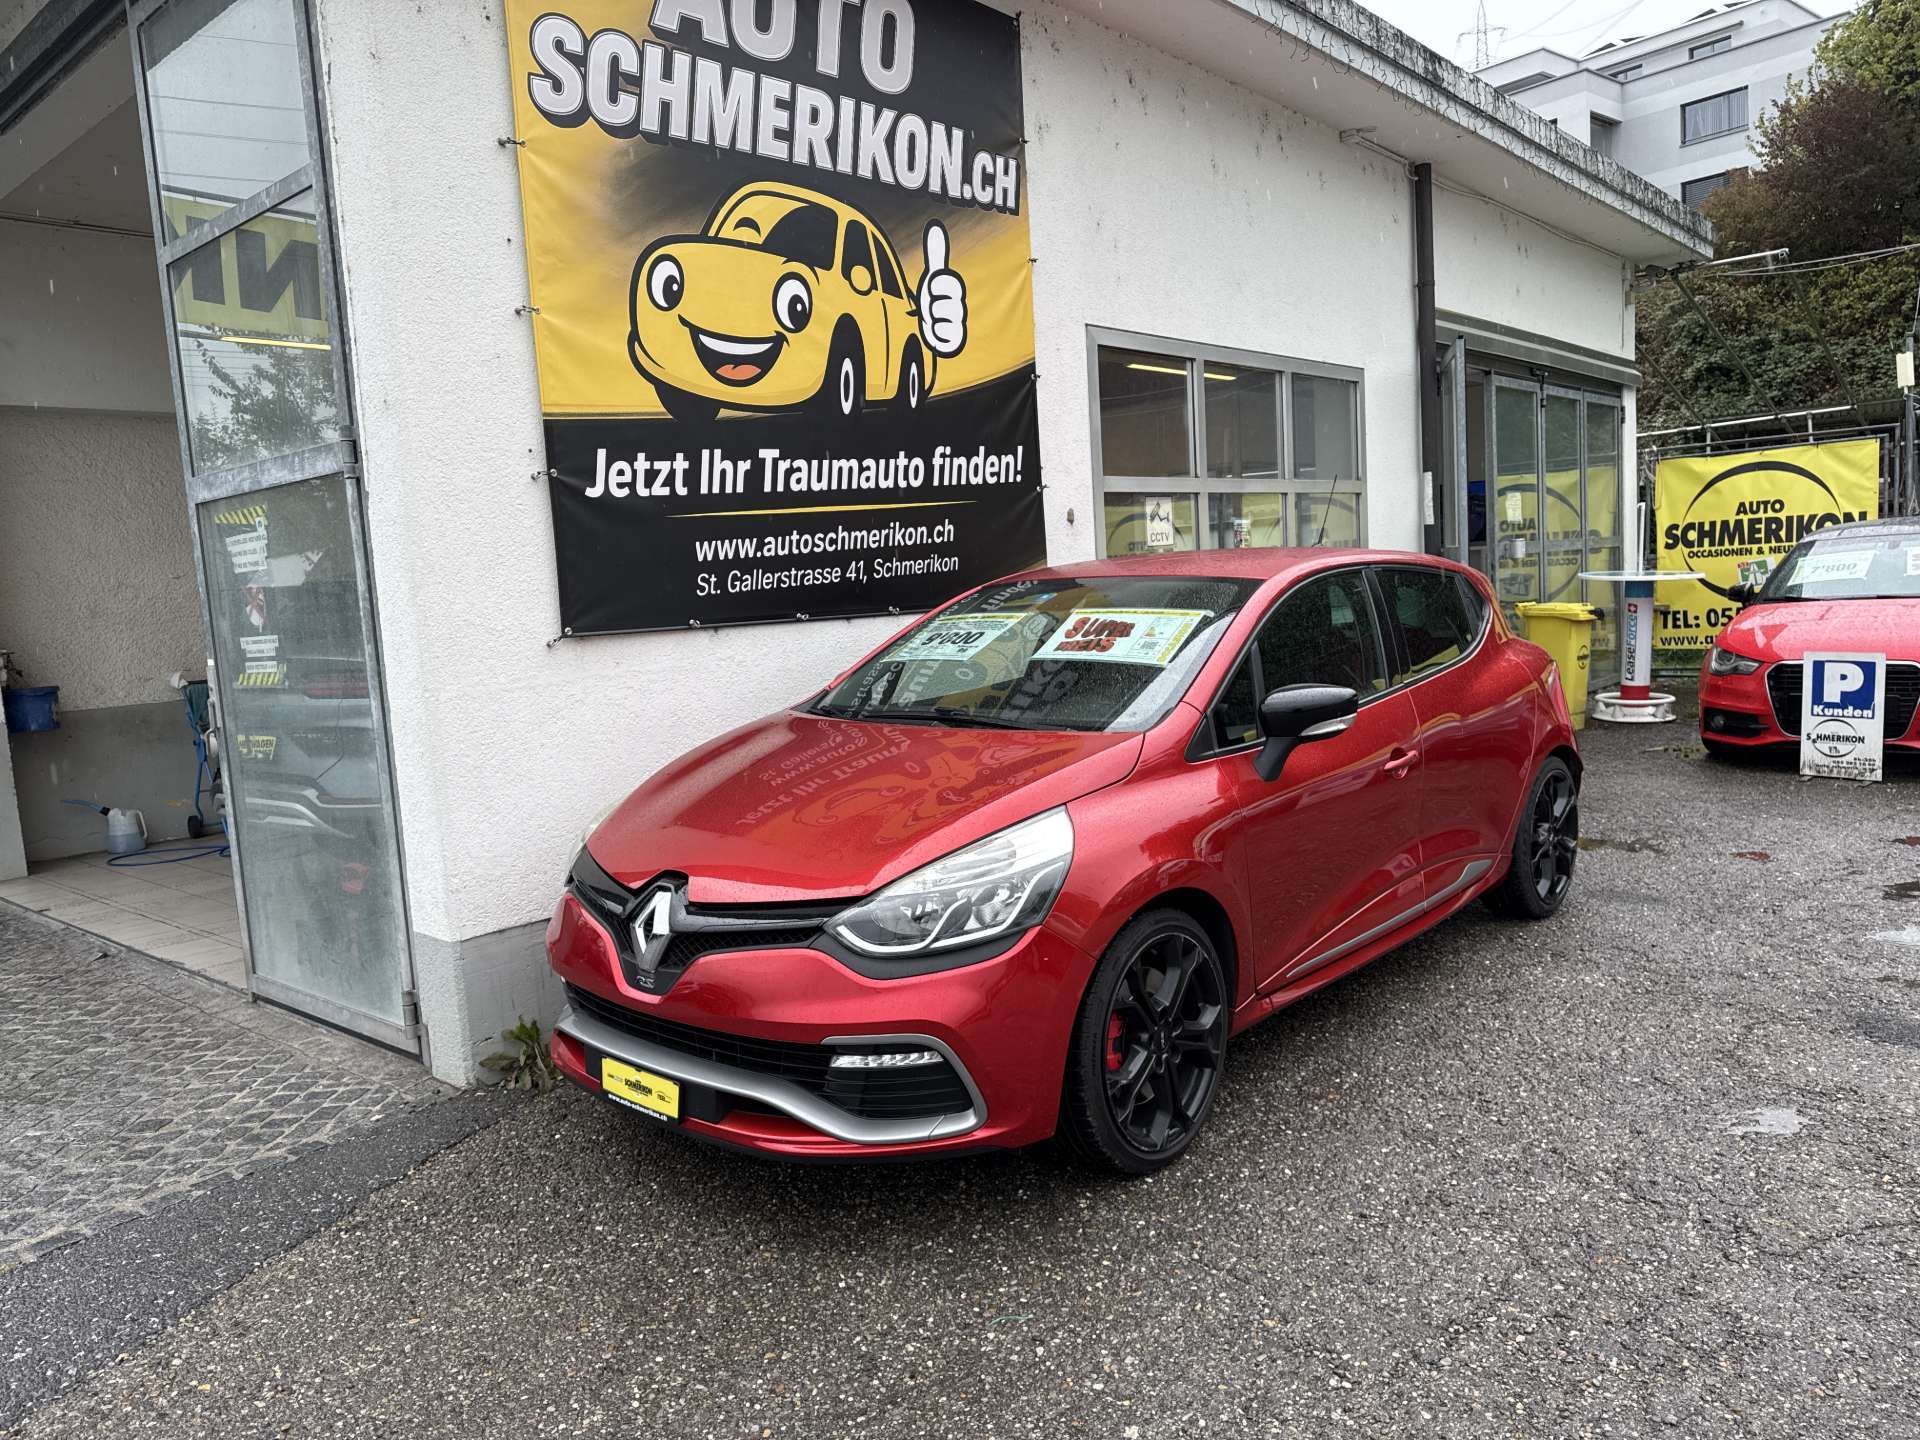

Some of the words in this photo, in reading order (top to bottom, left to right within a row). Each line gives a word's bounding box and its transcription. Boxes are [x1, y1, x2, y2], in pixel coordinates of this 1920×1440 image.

[530, 15, 1018, 209] SCHMERIKON.CH
[585, 447, 689, 498] Jetzt
[700, 449, 751, 494] Ihr
[758, 448, 924, 493] Traumauto
[932, 445, 1023, 485] finden!
[1735, 499, 1785, 516] AUTO
[695, 519, 955, 562] www.autoschmerikon.ch
[1151, 532, 1170, 543] CCTV
[1687, 547, 1752, 559] OCCASIONEN
[1756, 548, 1765, 556] &
[1769, 545, 1795, 554] NEU
[696, 573, 721, 596] St.
[727, 564, 841, 592] Gallerstrasse
[845, 563, 867, 585] 41,
[873, 555, 959, 579] Schmerikon
[1660, 609, 1701, 629] TEL:
[1625, 614, 1638, 681] LeaseForce
[1823, 662, 1865, 703] P
[1812, 703, 1874, 718] Kunden
[1806, 732, 1865, 744] SHMERIKON
